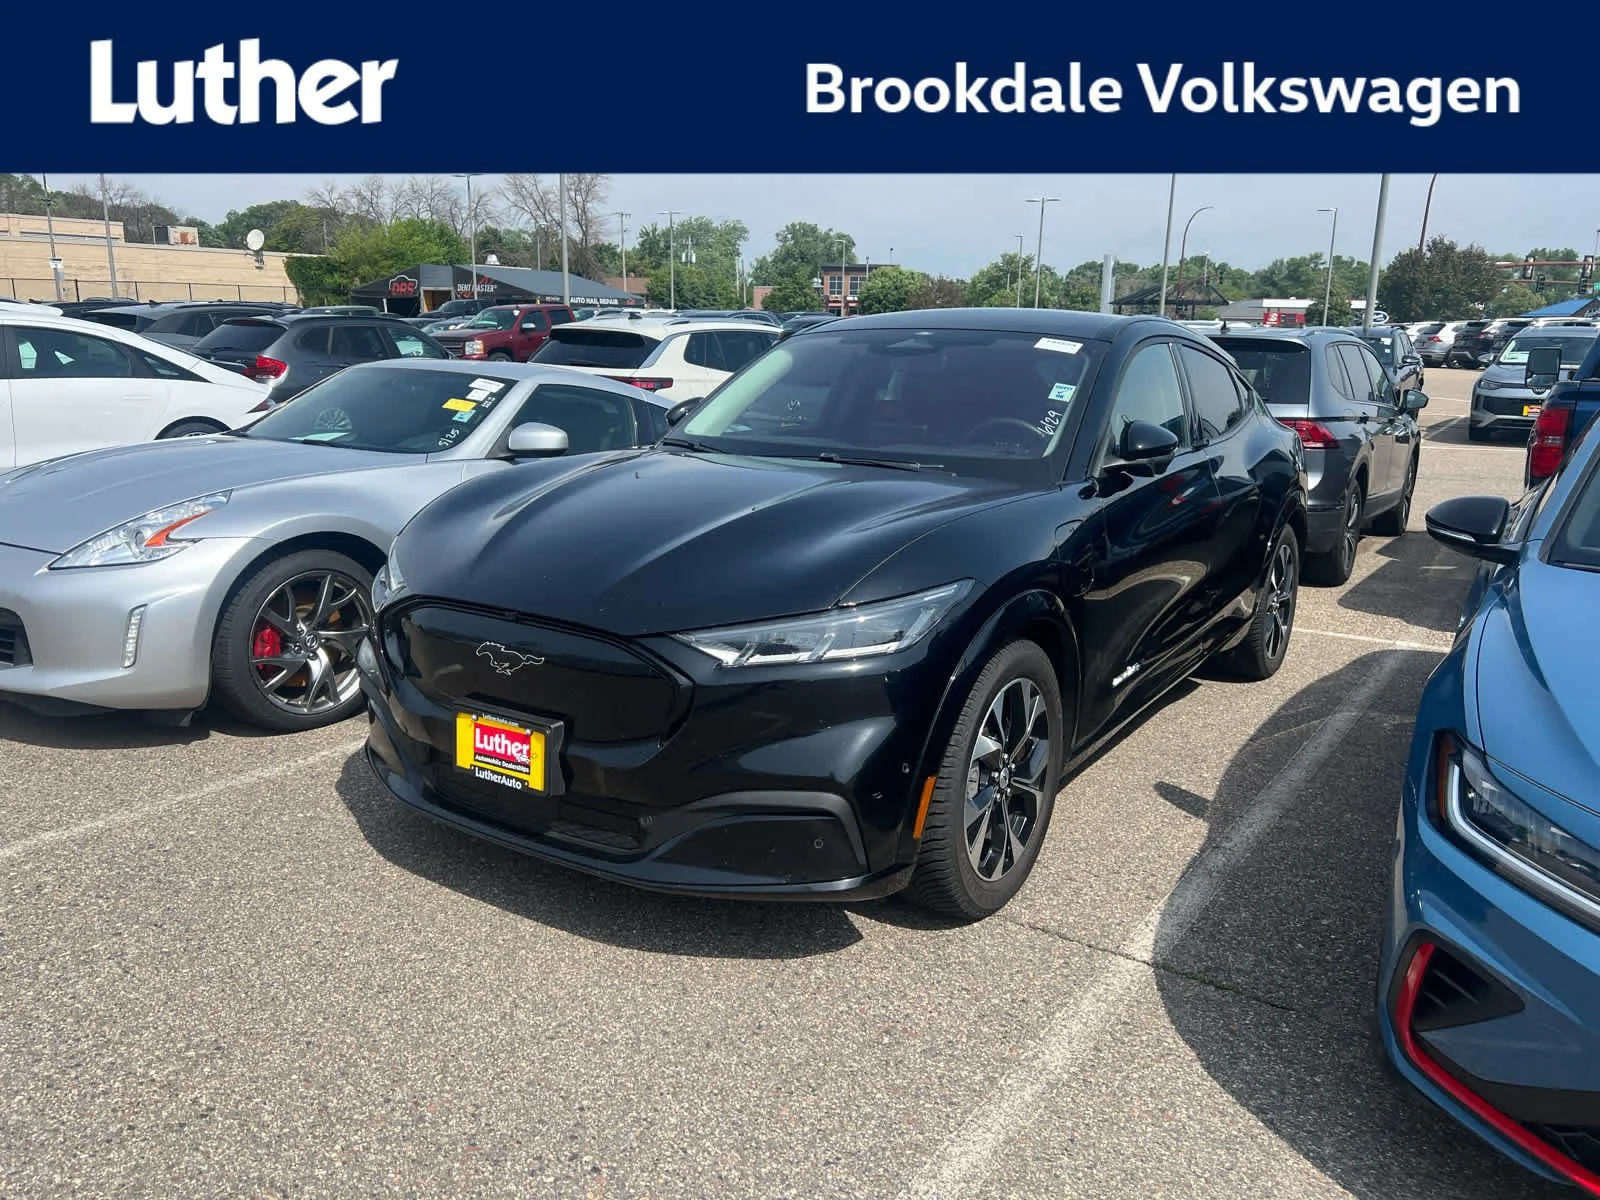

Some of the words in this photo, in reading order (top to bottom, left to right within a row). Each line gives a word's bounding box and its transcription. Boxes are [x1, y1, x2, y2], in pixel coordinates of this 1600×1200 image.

[457, 283, 471, 292] DENT
[570, 296, 585, 304] AUTO
[586, 297, 599, 305] HAIL
[475, 728, 529, 759] Luther
[475, 754, 501, 767] Automobile
[502, 760, 529, 773] Dealerships
[475, 767, 522, 790] LutherAuto
